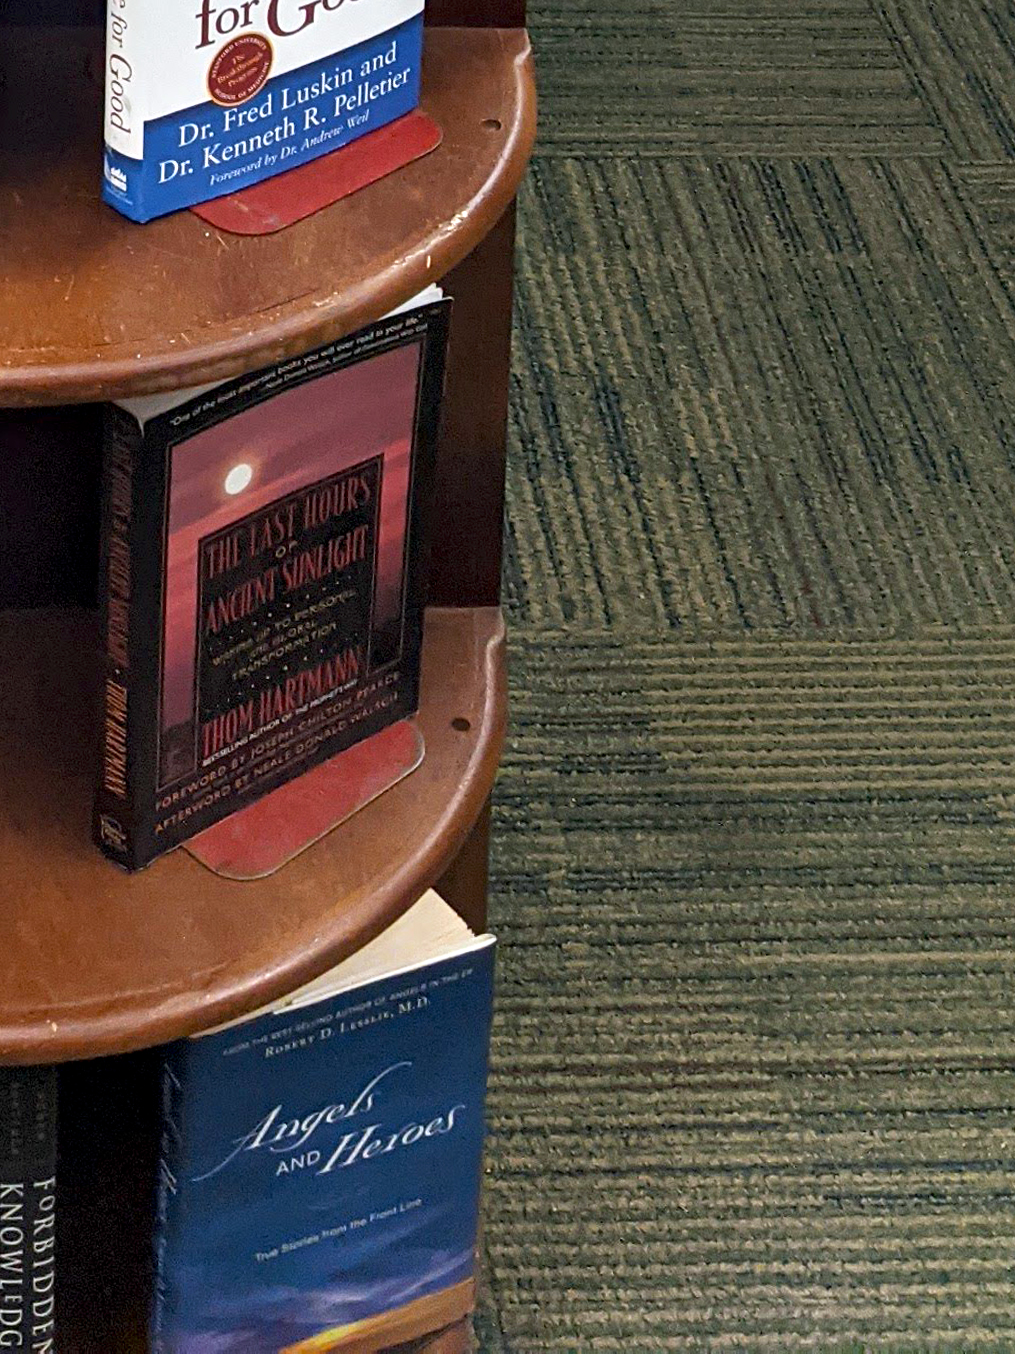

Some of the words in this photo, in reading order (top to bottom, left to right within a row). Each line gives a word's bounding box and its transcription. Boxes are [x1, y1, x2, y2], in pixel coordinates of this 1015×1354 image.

[110, 12, 129, 48] for
[109, 54, 133, 134] Good
[158, 157, 195, 184] Dr.
[202, 118, 296, 169] Kenneth
[303, 106, 327, 132] R.
[334, 66, 412, 118] Pelletier
[178, 120, 215, 148] Dr.
[223, 96, 273, 132] Fred
[281, 69, 354, 111] Luskin
[359, 40, 398, 79] and
[209, 159, 263, 186] Foreword
[263, 151, 279, 168] by
[281, 143, 298, 161] Dr.
[301, 125, 344, 153] Andrew
[347, 110, 370, 133] Weil
[191, 1060, 413, 1183] Angels
[275, 1150, 322, 1177] AND
[315, 1104, 466, 1176] Heroes
[32, 1174, 55, 1354] FORBIDDEN
